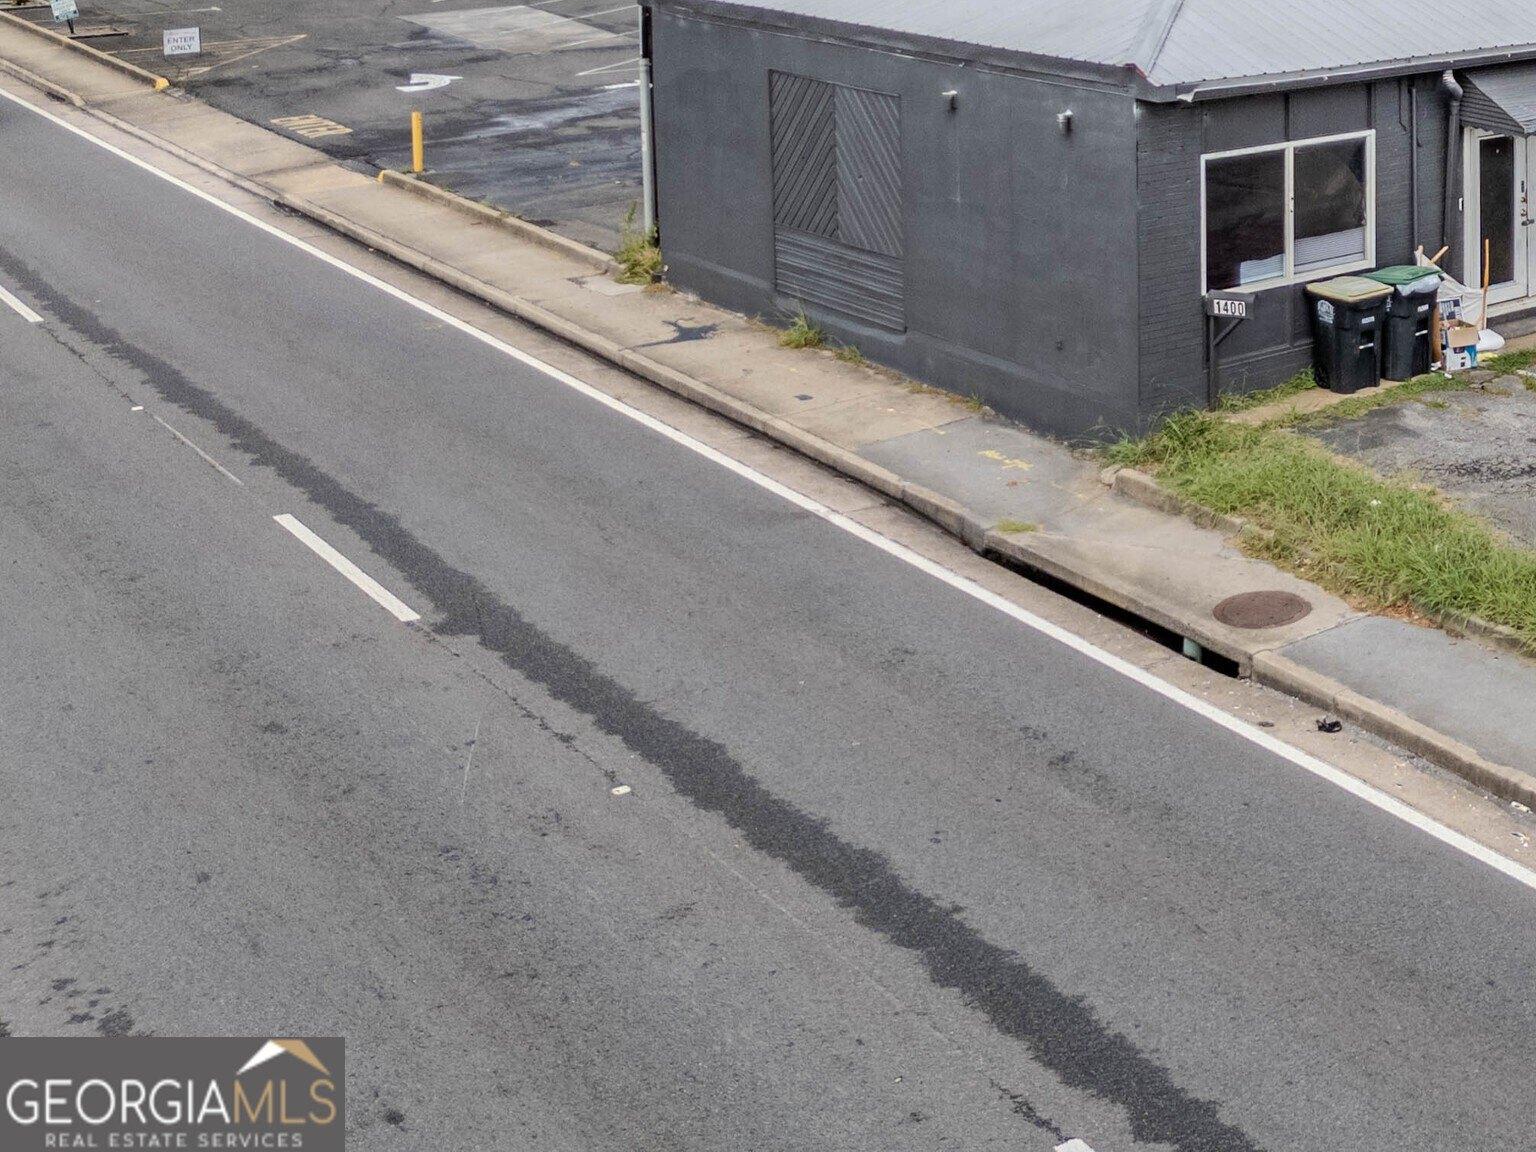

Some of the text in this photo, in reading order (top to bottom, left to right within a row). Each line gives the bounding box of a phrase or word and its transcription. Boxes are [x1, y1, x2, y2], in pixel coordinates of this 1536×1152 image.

[167, 35, 195, 45] ENTER
[170, 44, 193, 52] ONLY
[1216, 301, 1244, 316] 1400
